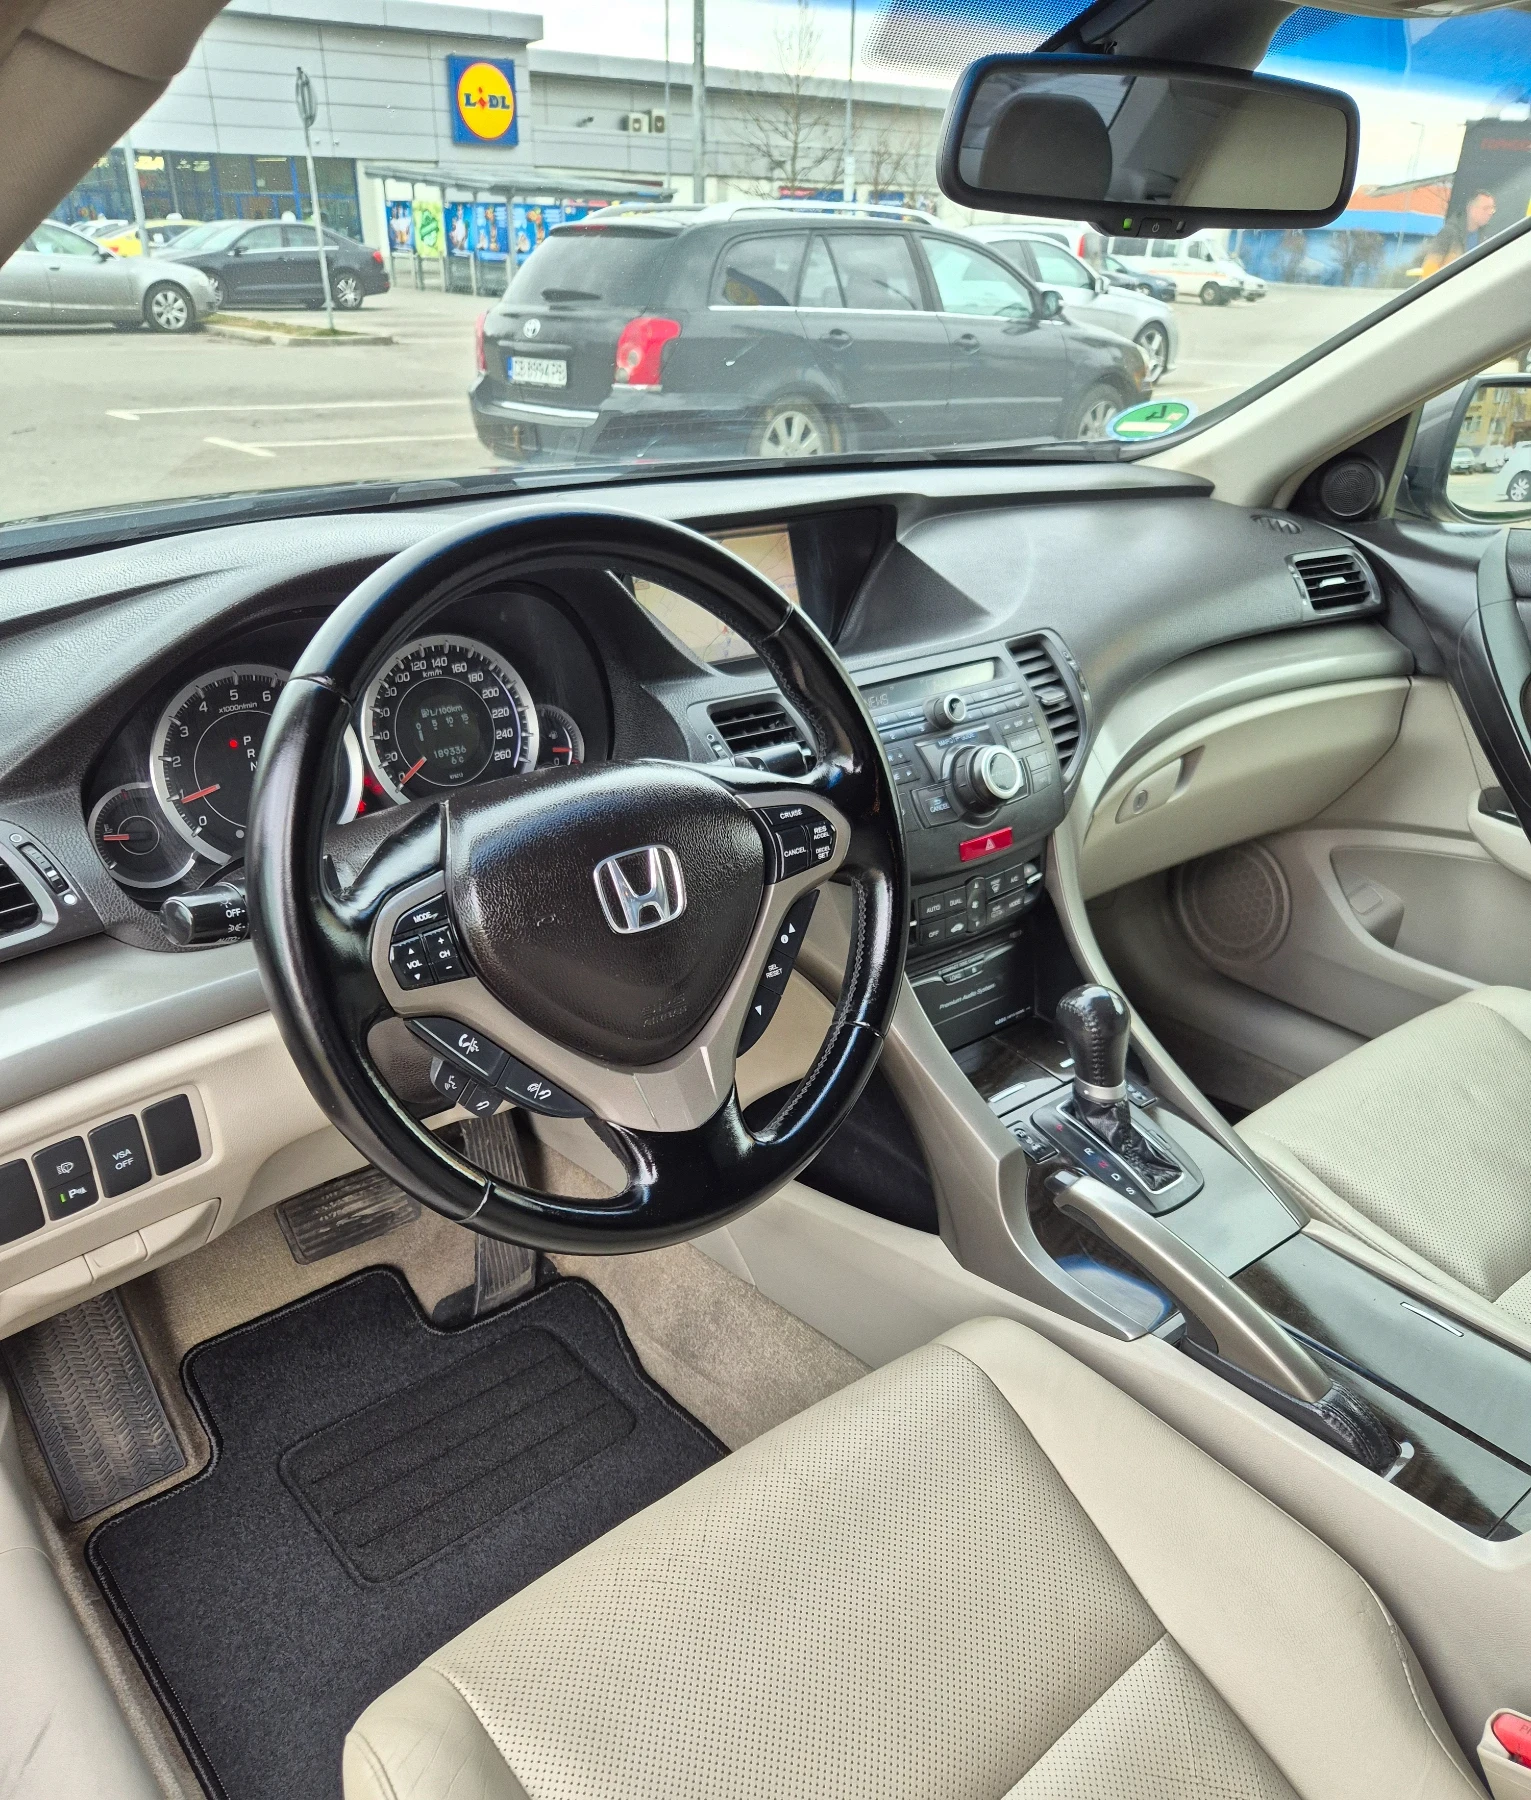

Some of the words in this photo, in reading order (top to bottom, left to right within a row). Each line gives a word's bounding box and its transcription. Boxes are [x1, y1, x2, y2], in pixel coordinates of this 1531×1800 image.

[411, 660, 426, 671] 120
[431, 657, 447, 668] 140
[451, 662, 467, 673] 160
[394, 672, 410, 683] 100
[422, 670, 443, 678] km/h
[468, 674, 484, 683] 180
[229, 689, 239, 701] 5
[262, 691, 271, 702] 6
[482, 688, 499, 699] 200
[198, 701, 208, 713] 4
[492, 707, 509, 718] 220
[415, 722, 422, 730] 0
[431, 719, 438, 727] 5
[445, 716, 454, 724] 10
[461, 713, 469, 721] 15
[180, 725, 189, 738] 3
[496, 728, 513, 739] 240
[243, 736, 252, 745] P
[247, 748, 255, 758] R
[433, 745, 467, 758] 189336
[494, 749, 512, 761] 260
[172, 756, 182, 767] 2
[554, 757, 559, 766] 0
[930, 803, 950, 813] CANCEL
[779, 808, 803, 820] CRUISE
[199, 816, 207, 826] 0
[813, 825, 827, 834] RES
[783, 846, 807, 858] CANCEL
[817, 851, 829, 859] SET
[949, 899, 963, 907] DUAL
[225, 909, 241, 919] OFF
[926, 904, 941, 914] AUTO
[412, 912, 433, 924] MODE
[928, 930, 939, 938] OFF
[439, 950, 450, 958] CH
[406, 960, 423, 970] VOL
[765, 968, 783, 979] RESET
[939, 997, 962, 1010] Premium
[962, 991, 977, 1000] Audio
[977, 983, 996, 995] System
[1056, 1124, 1063, 1132] P
[112, 1148, 132, 1161] VSA
[1084, 1147, 1094, 1156] R
[115, 1157, 134, 1170] OFF
[1110, 1173, 1121, 1182] D
[1125, 1186, 1135, 1196] S
